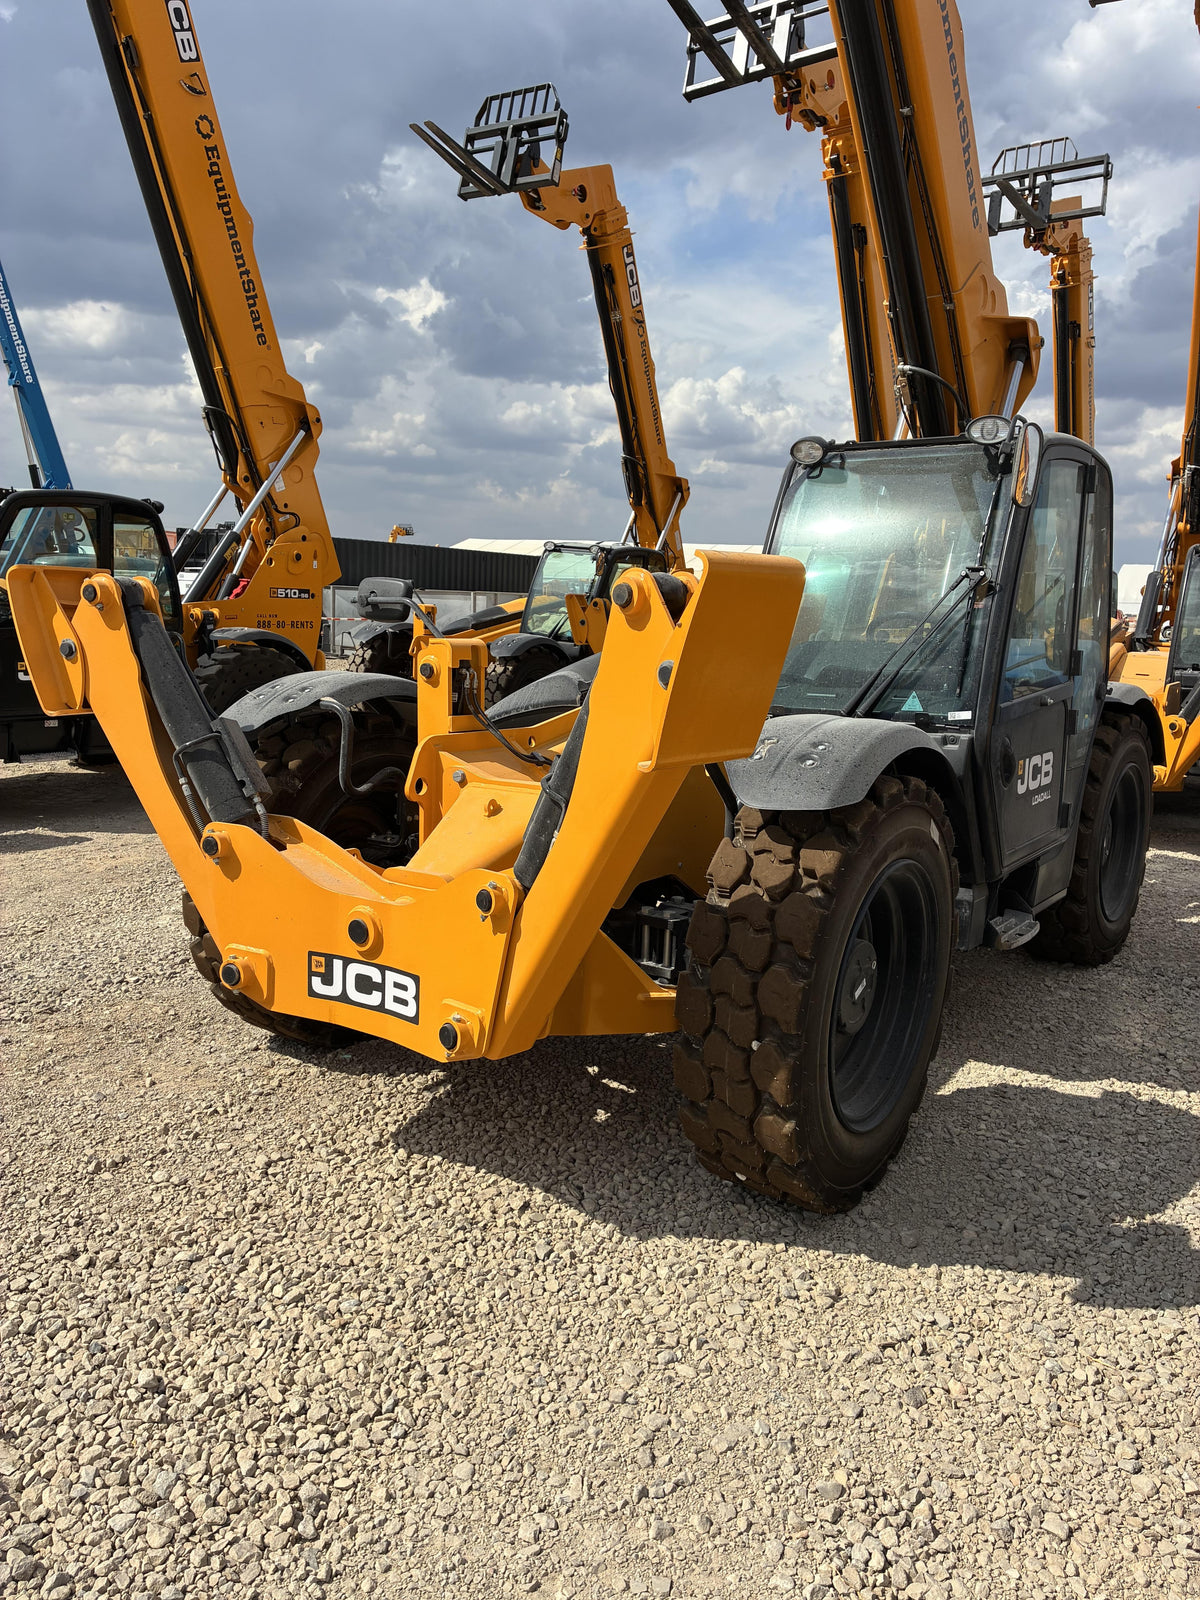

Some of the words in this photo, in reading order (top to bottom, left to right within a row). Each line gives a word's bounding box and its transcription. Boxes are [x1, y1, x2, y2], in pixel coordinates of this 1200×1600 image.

[168, 0, 197, 61] CB
[204, 144, 267, 347] EquipmentShare
[623, 246, 641, 307] JCB
[0, 272, 34, 384] uipmentShare
[640, 340, 662, 446] EquipmentShare
[256, 620, 314, 629] 888-80-RENTS
[1017, 751, 1054, 795] JCB
[311, 958, 417, 1018] JCB
